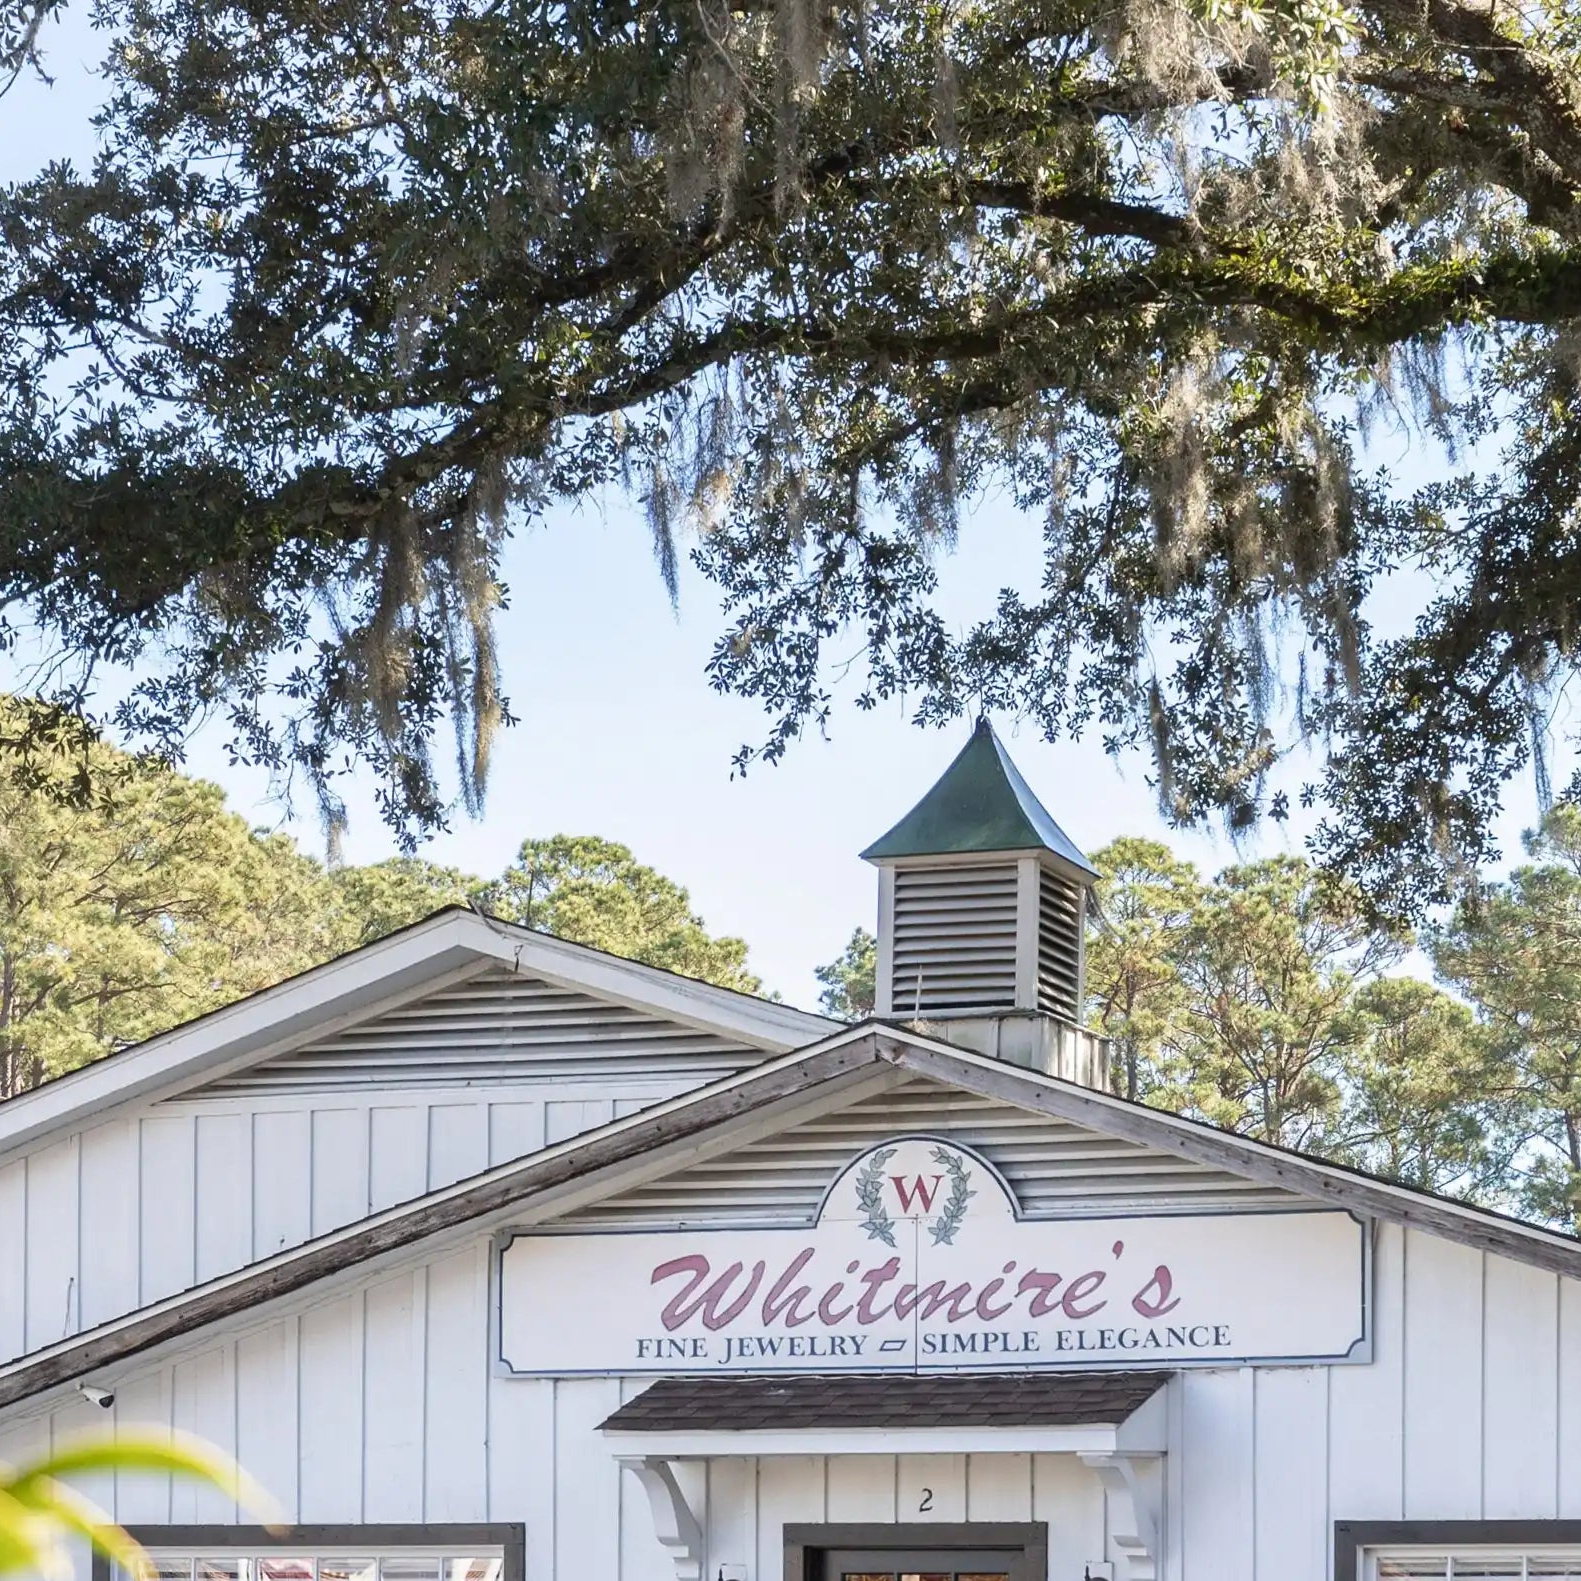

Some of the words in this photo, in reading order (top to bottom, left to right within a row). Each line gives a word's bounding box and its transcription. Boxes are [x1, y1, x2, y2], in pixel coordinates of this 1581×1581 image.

[889, 1174, 944, 1215] W
[651, 1240, 1181, 1332] Whitmire's
[636, 1337, 709, 1359] FINE
[718, 1334, 869, 1365] JEWELRY
[921, 1330, 1040, 1355] SIMPLE
[1055, 1324, 1233, 1351] ELEGANCE
[919, 1488, 933, 1513] 2
